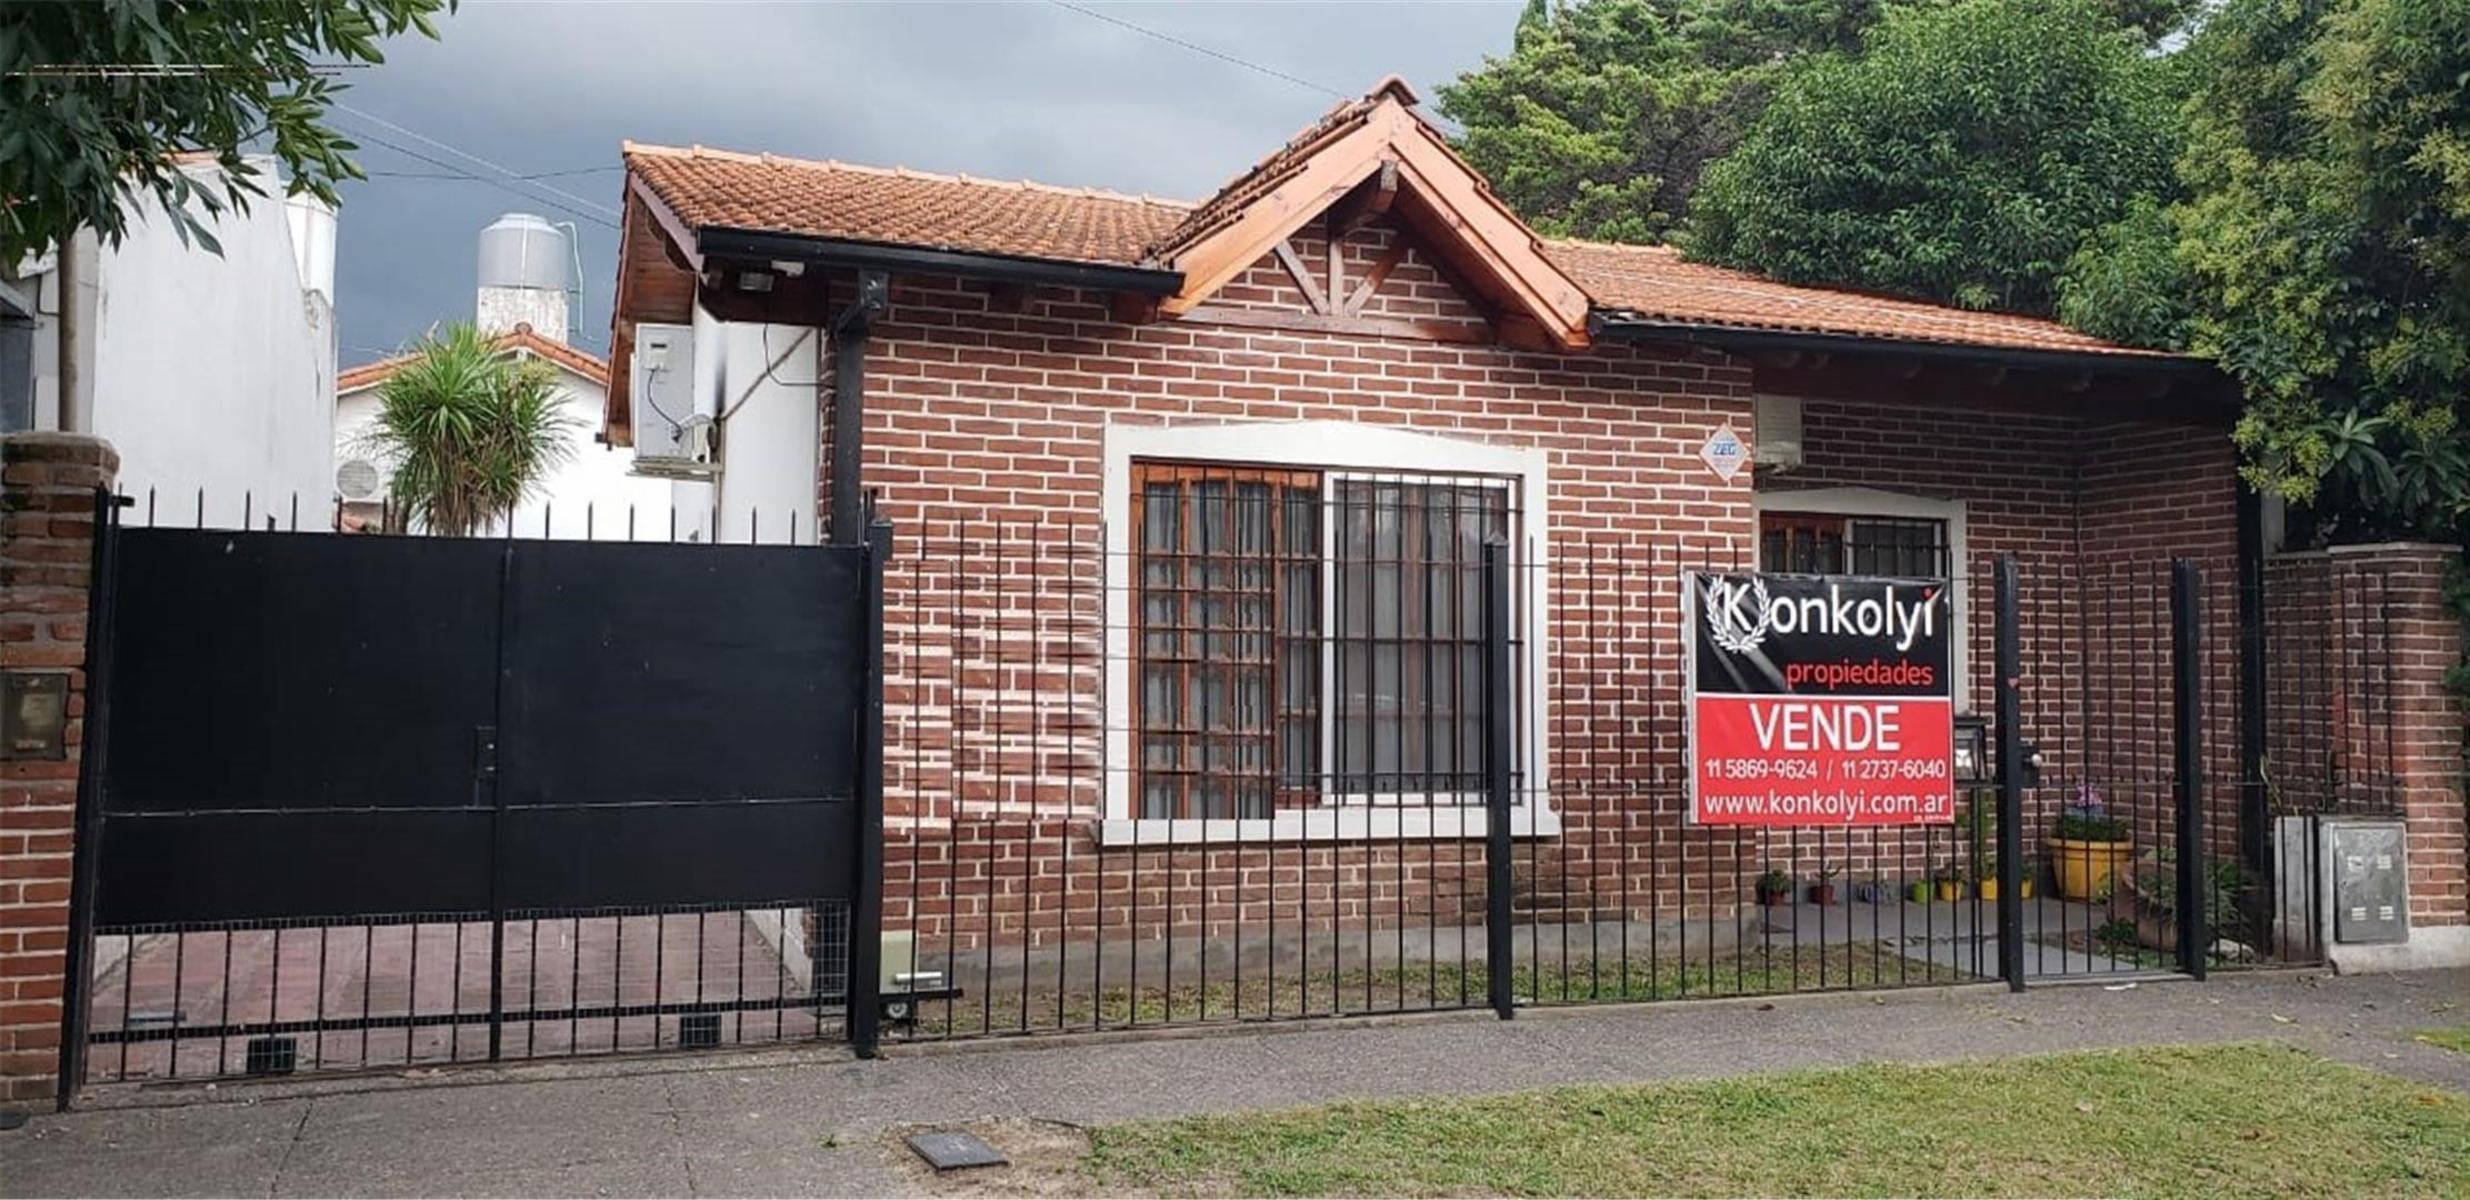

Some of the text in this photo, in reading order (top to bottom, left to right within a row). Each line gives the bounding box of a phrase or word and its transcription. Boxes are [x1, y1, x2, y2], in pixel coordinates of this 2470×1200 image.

[1722, 582, 1943, 651] Konkolyi
[1786, 659, 1934, 689] propiedades
[1749, 703, 1901, 751] VENDE
[1704, 758, 1721, 778] 11
[1725, 758, 1818, 779] 5869-9624
[1841, 759, 1857, 779] 11
[1860, 759, 1947, 779] 2737-6040
[1704, 788, 1949, 821] www.konkolyi.com.ar
